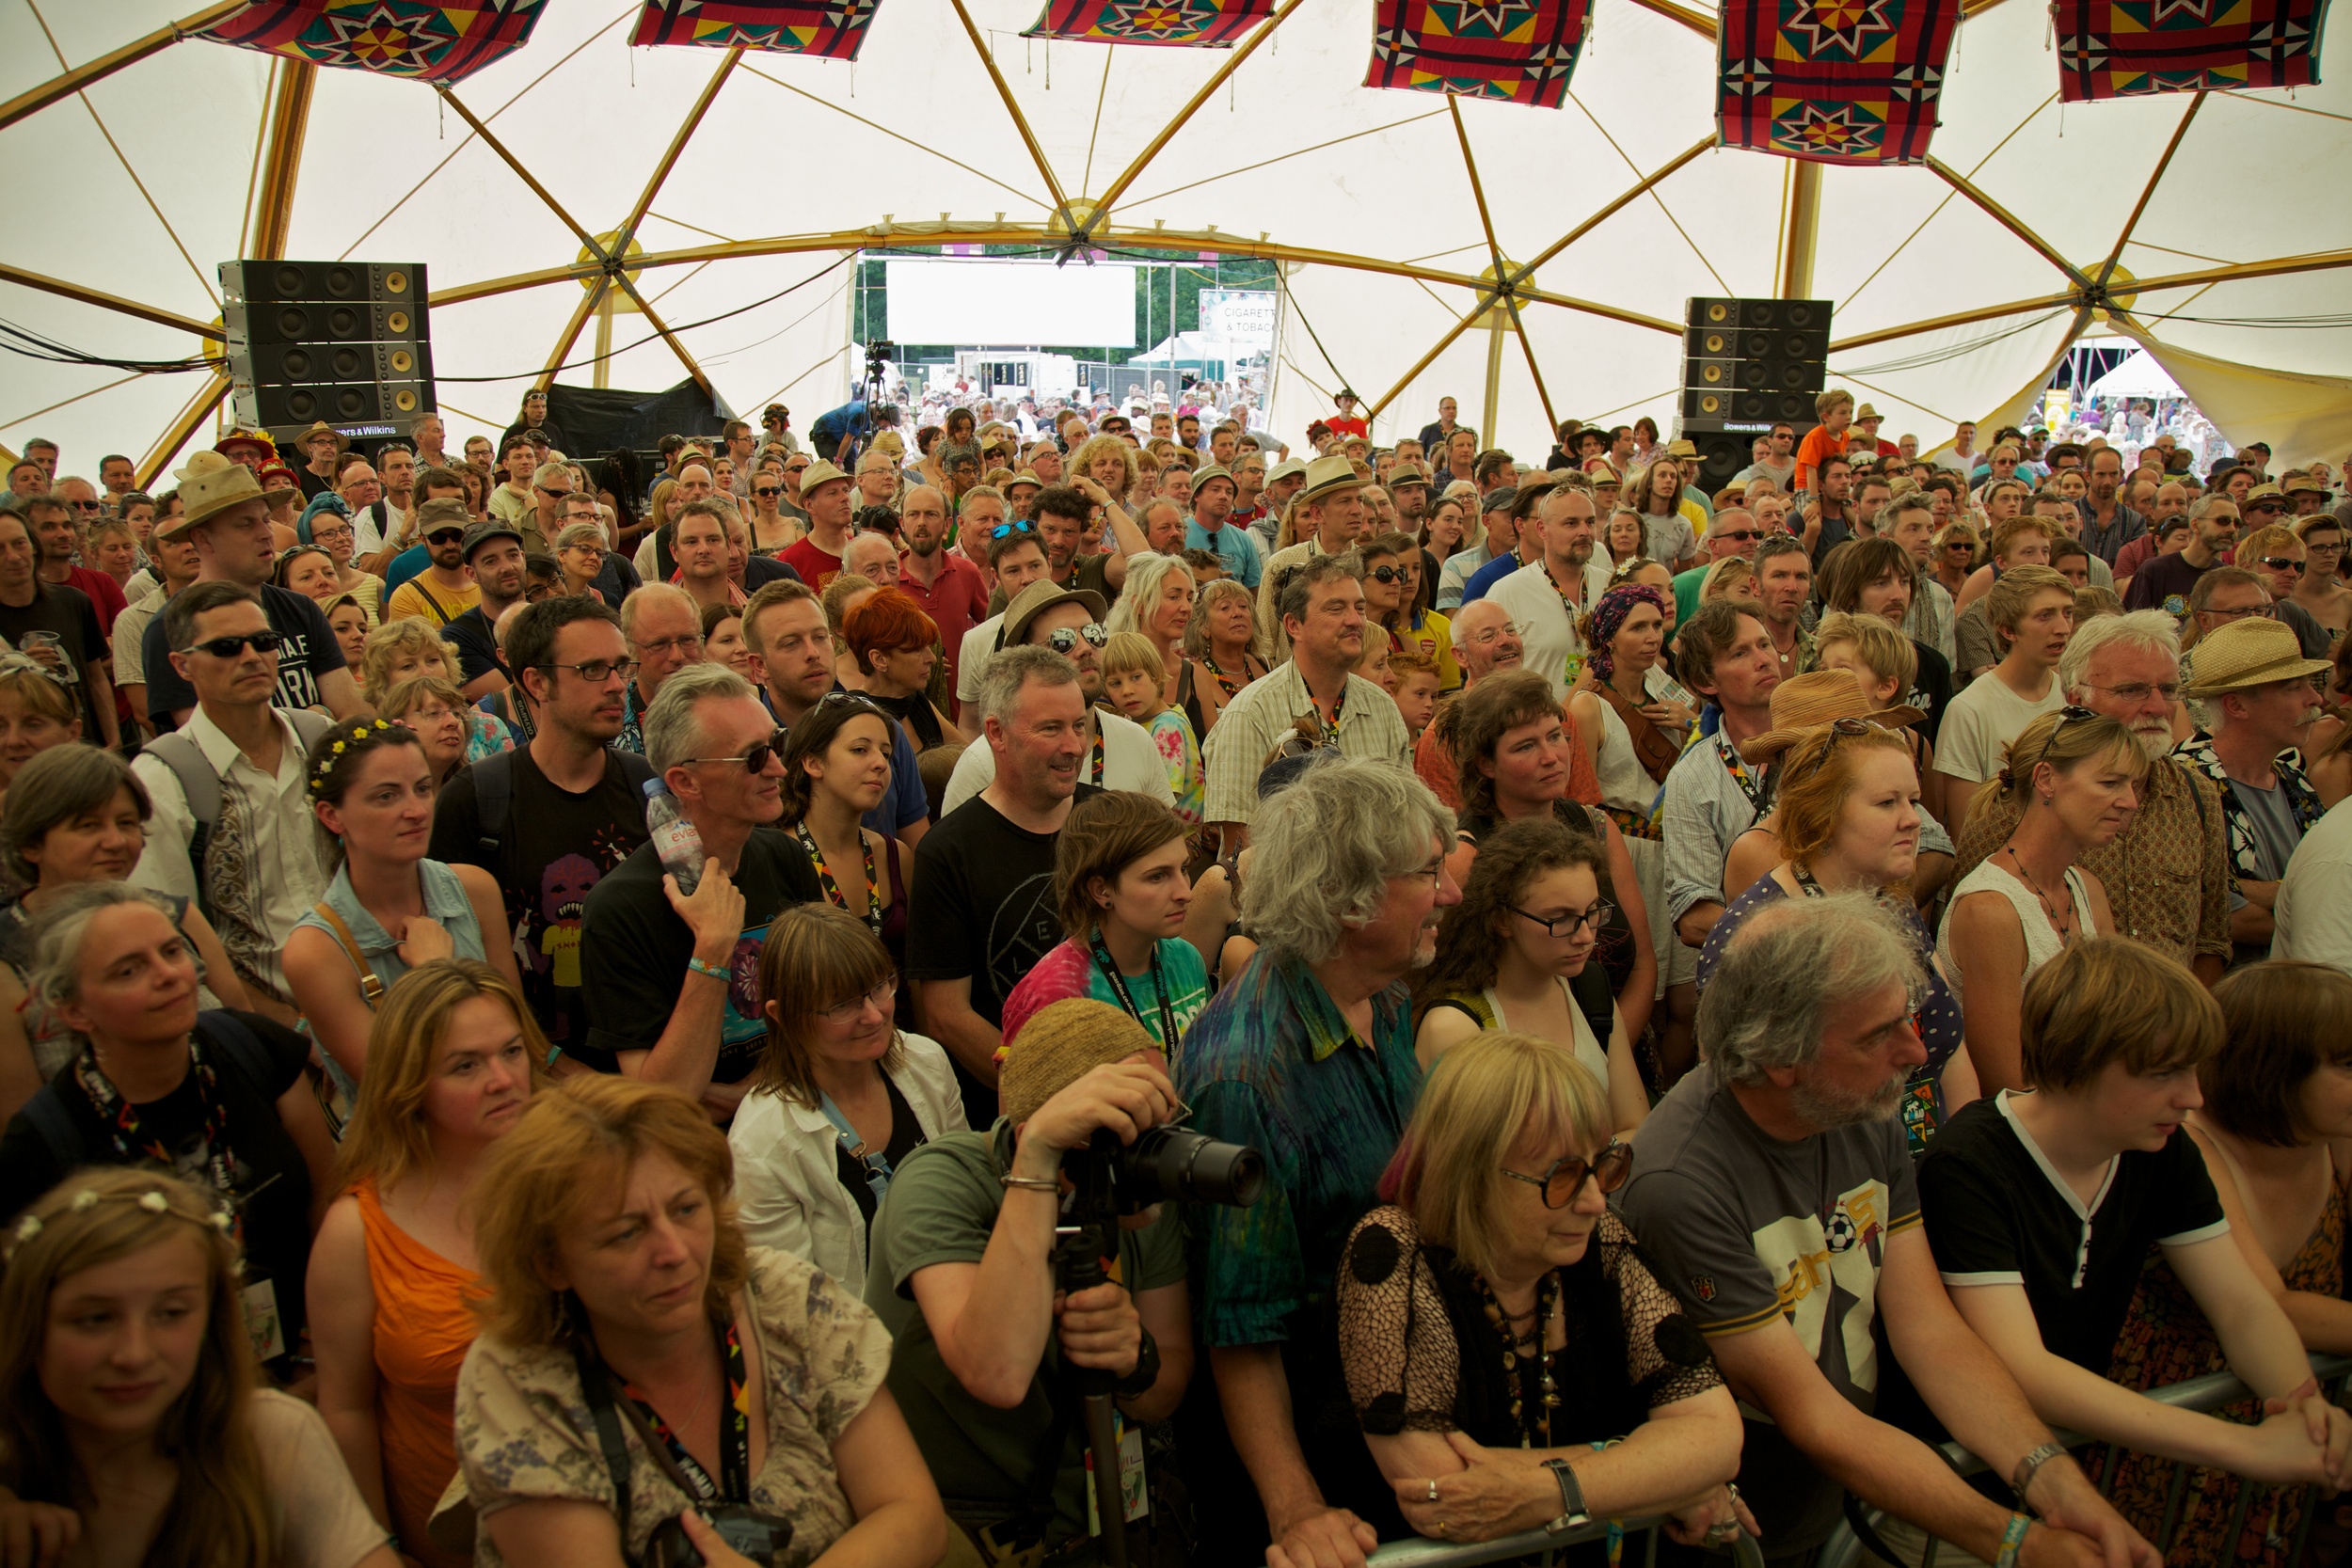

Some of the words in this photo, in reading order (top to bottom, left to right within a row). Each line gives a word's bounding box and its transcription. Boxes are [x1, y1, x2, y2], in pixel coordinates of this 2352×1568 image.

[1226, 324, 1232, 332] &
[357, 428, 364, 436] &
[363, 425, 396, 436] Wilkins
[1724, 422, 1751, 431] Bowers
[517, 700, 534, 736] OLYMPUS
